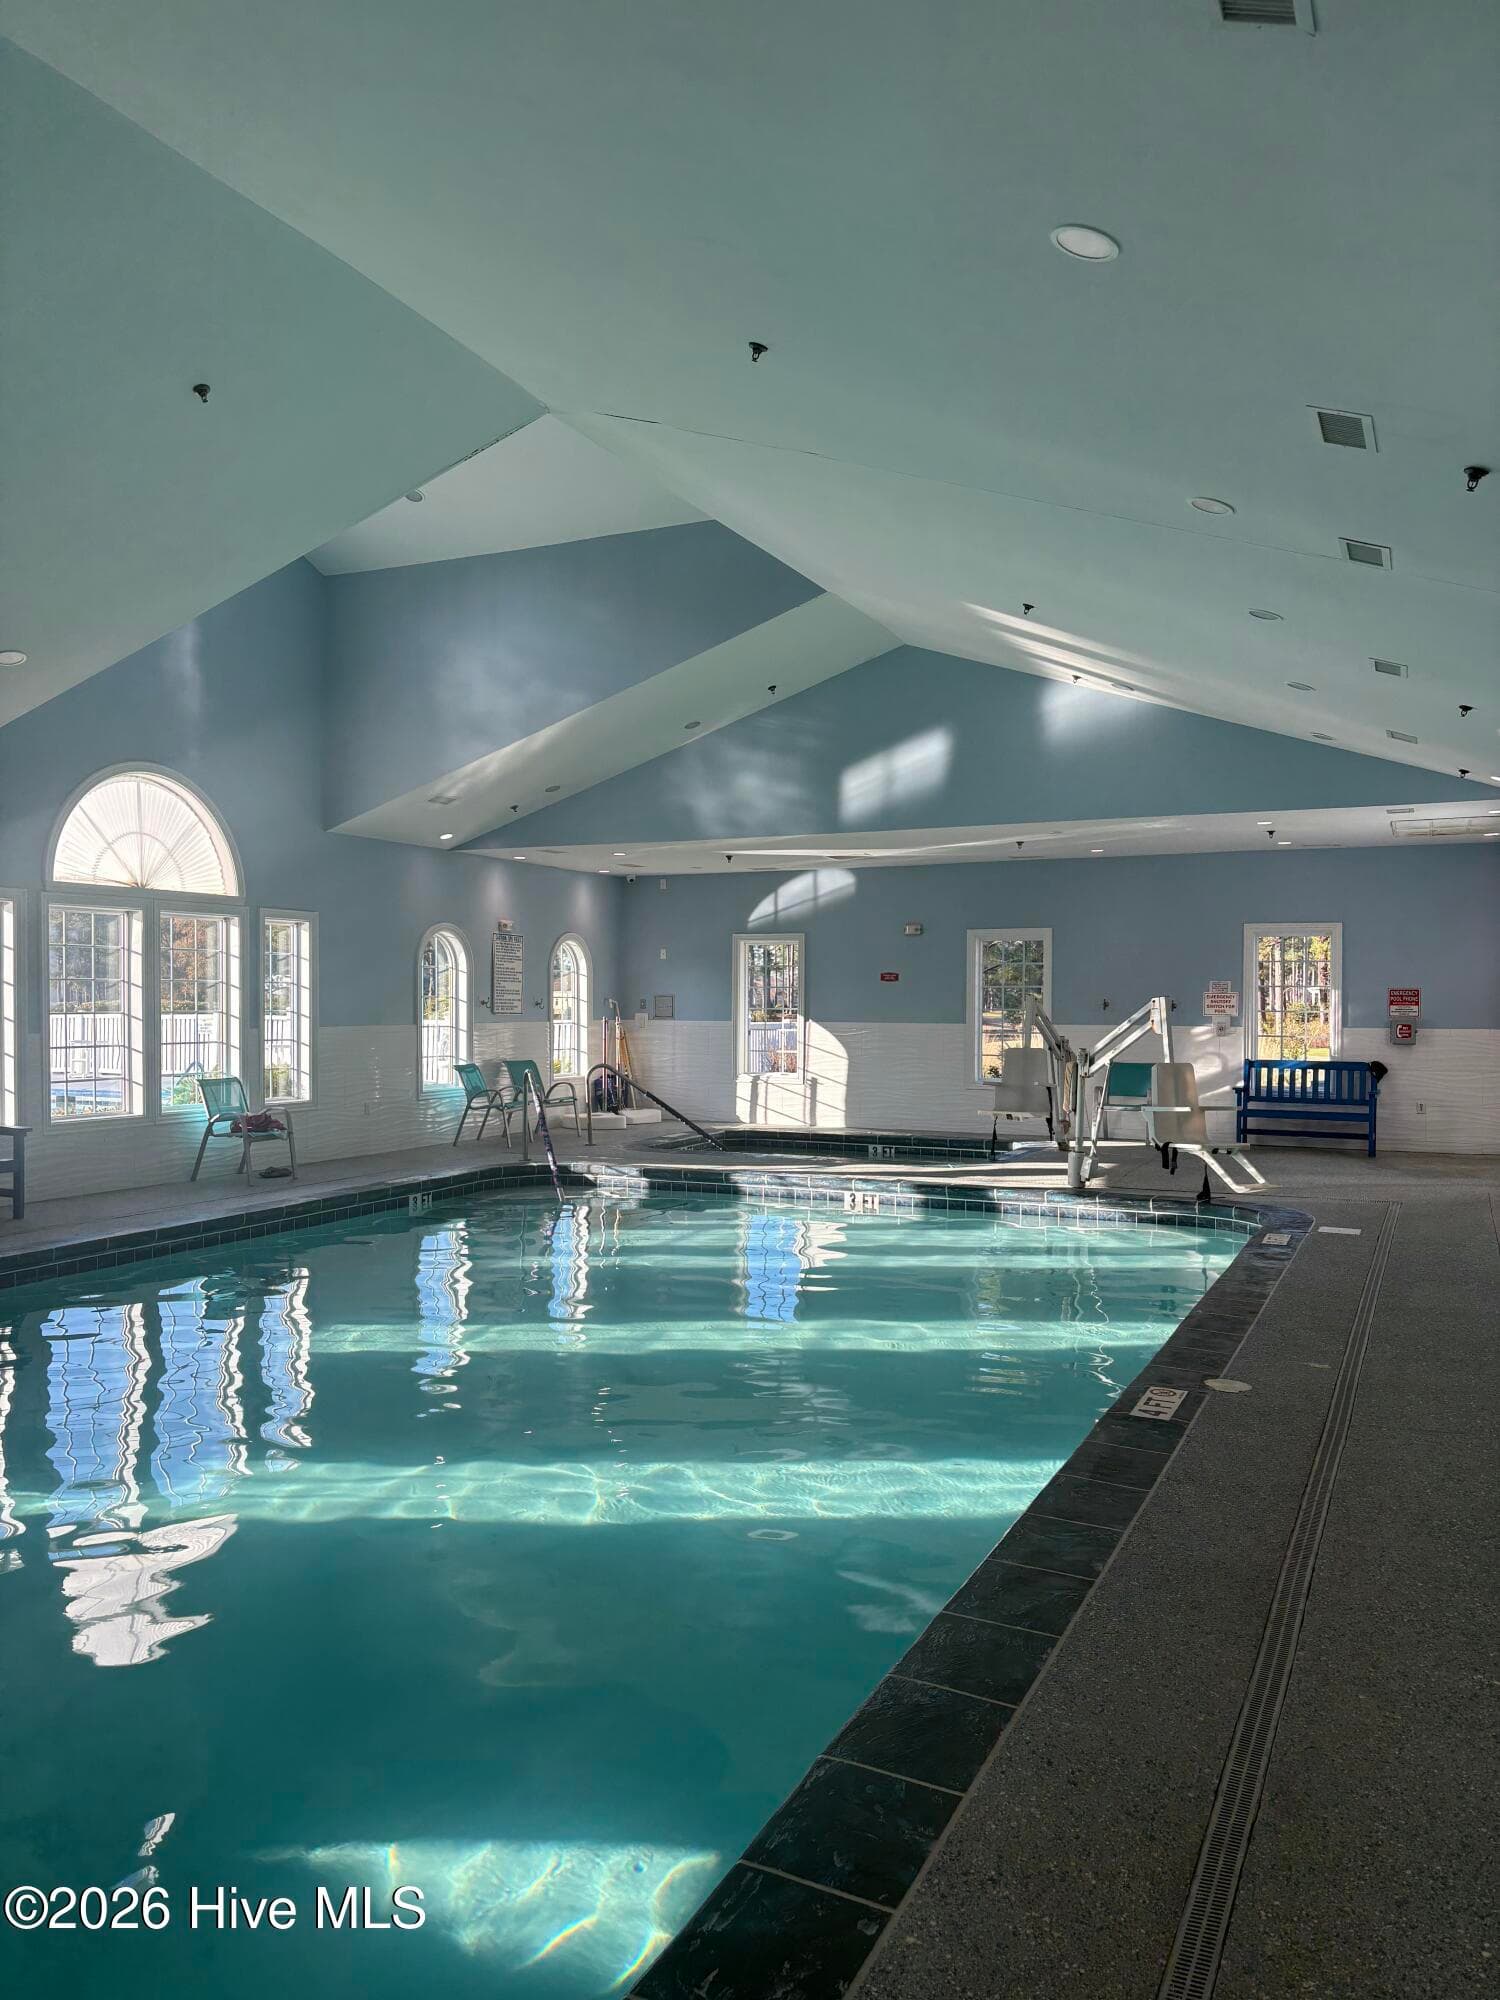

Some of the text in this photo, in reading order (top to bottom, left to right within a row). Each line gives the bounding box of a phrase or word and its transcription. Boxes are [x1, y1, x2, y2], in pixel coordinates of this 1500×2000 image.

[872, 1146, 893, 1158] 3 FT
[412, 1193, 431, 1211] 3 FT
[849, 1193, 877, 1213] 3 FT
